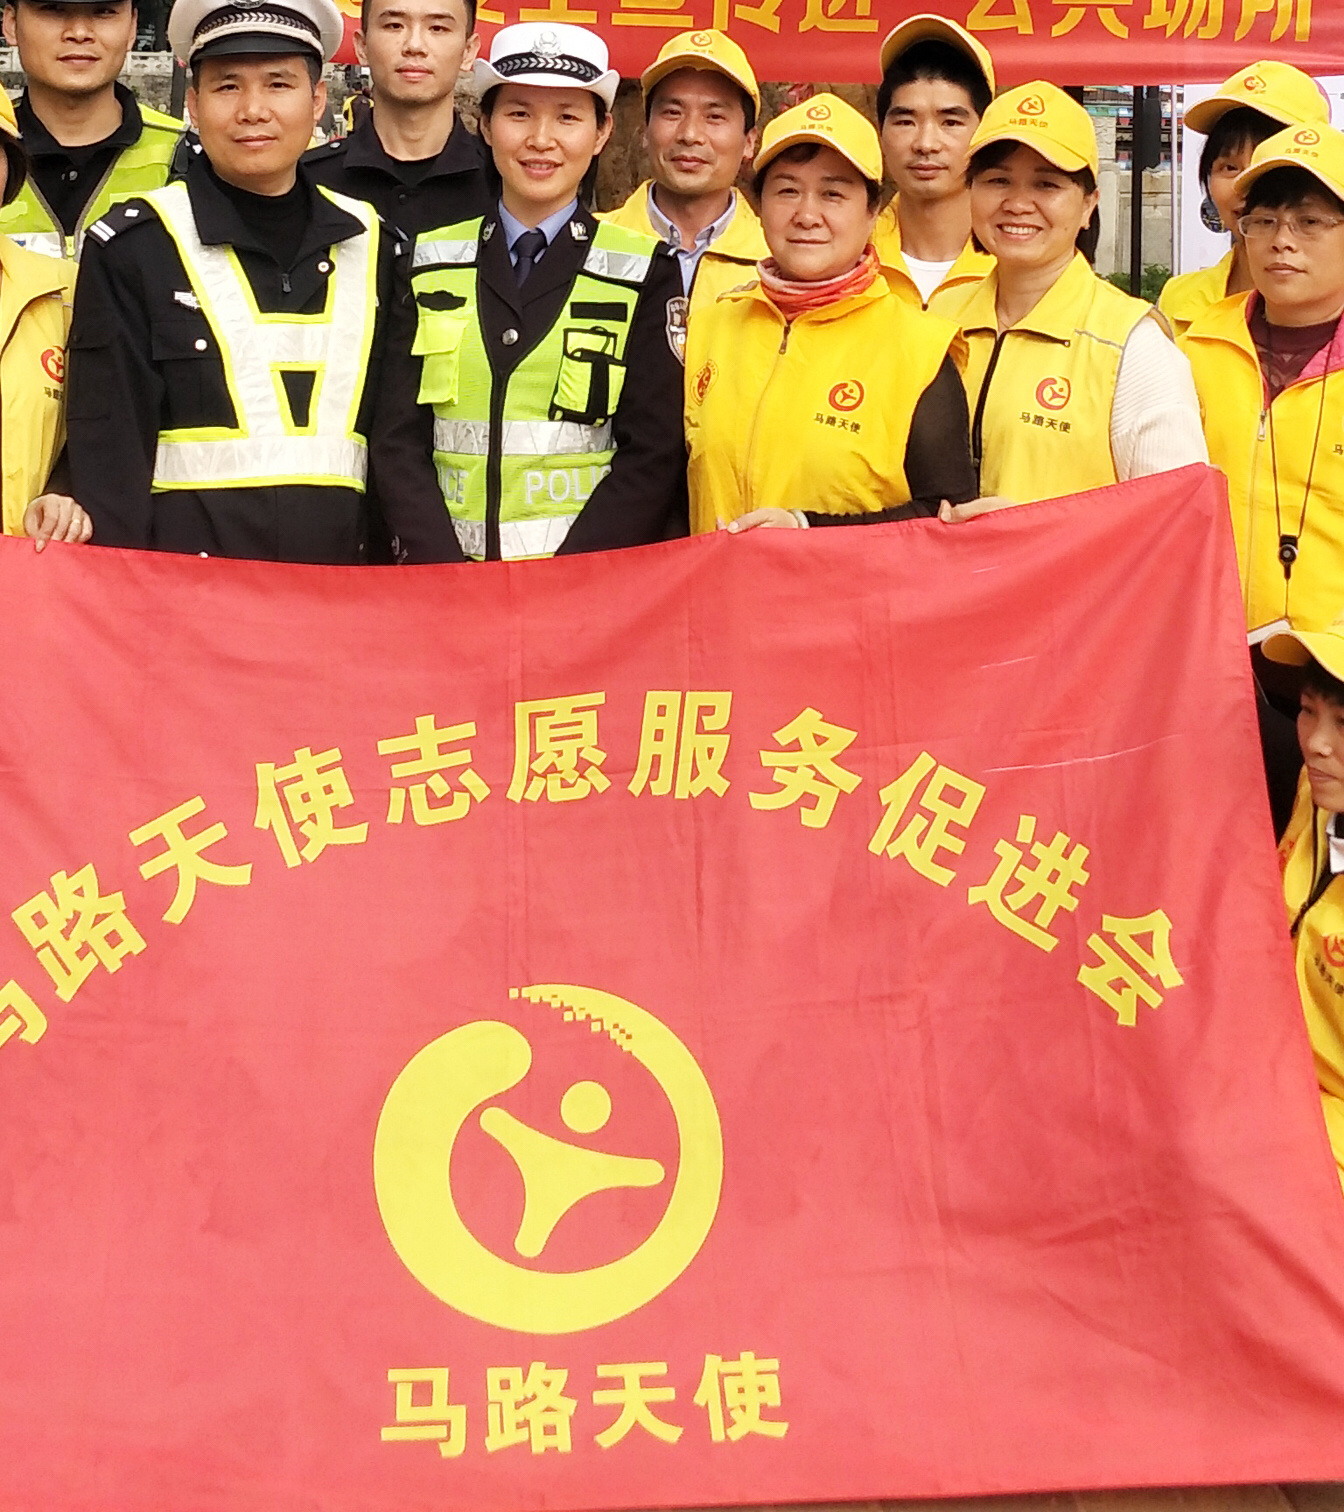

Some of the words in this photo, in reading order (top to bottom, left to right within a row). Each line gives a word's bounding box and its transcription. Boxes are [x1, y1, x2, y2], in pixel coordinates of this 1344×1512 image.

[813, 412, 862, 435] 马路天使
[1018, 411, 1072, 434] 马路天使
[379, 1351, 789, 1459] 马路天使
